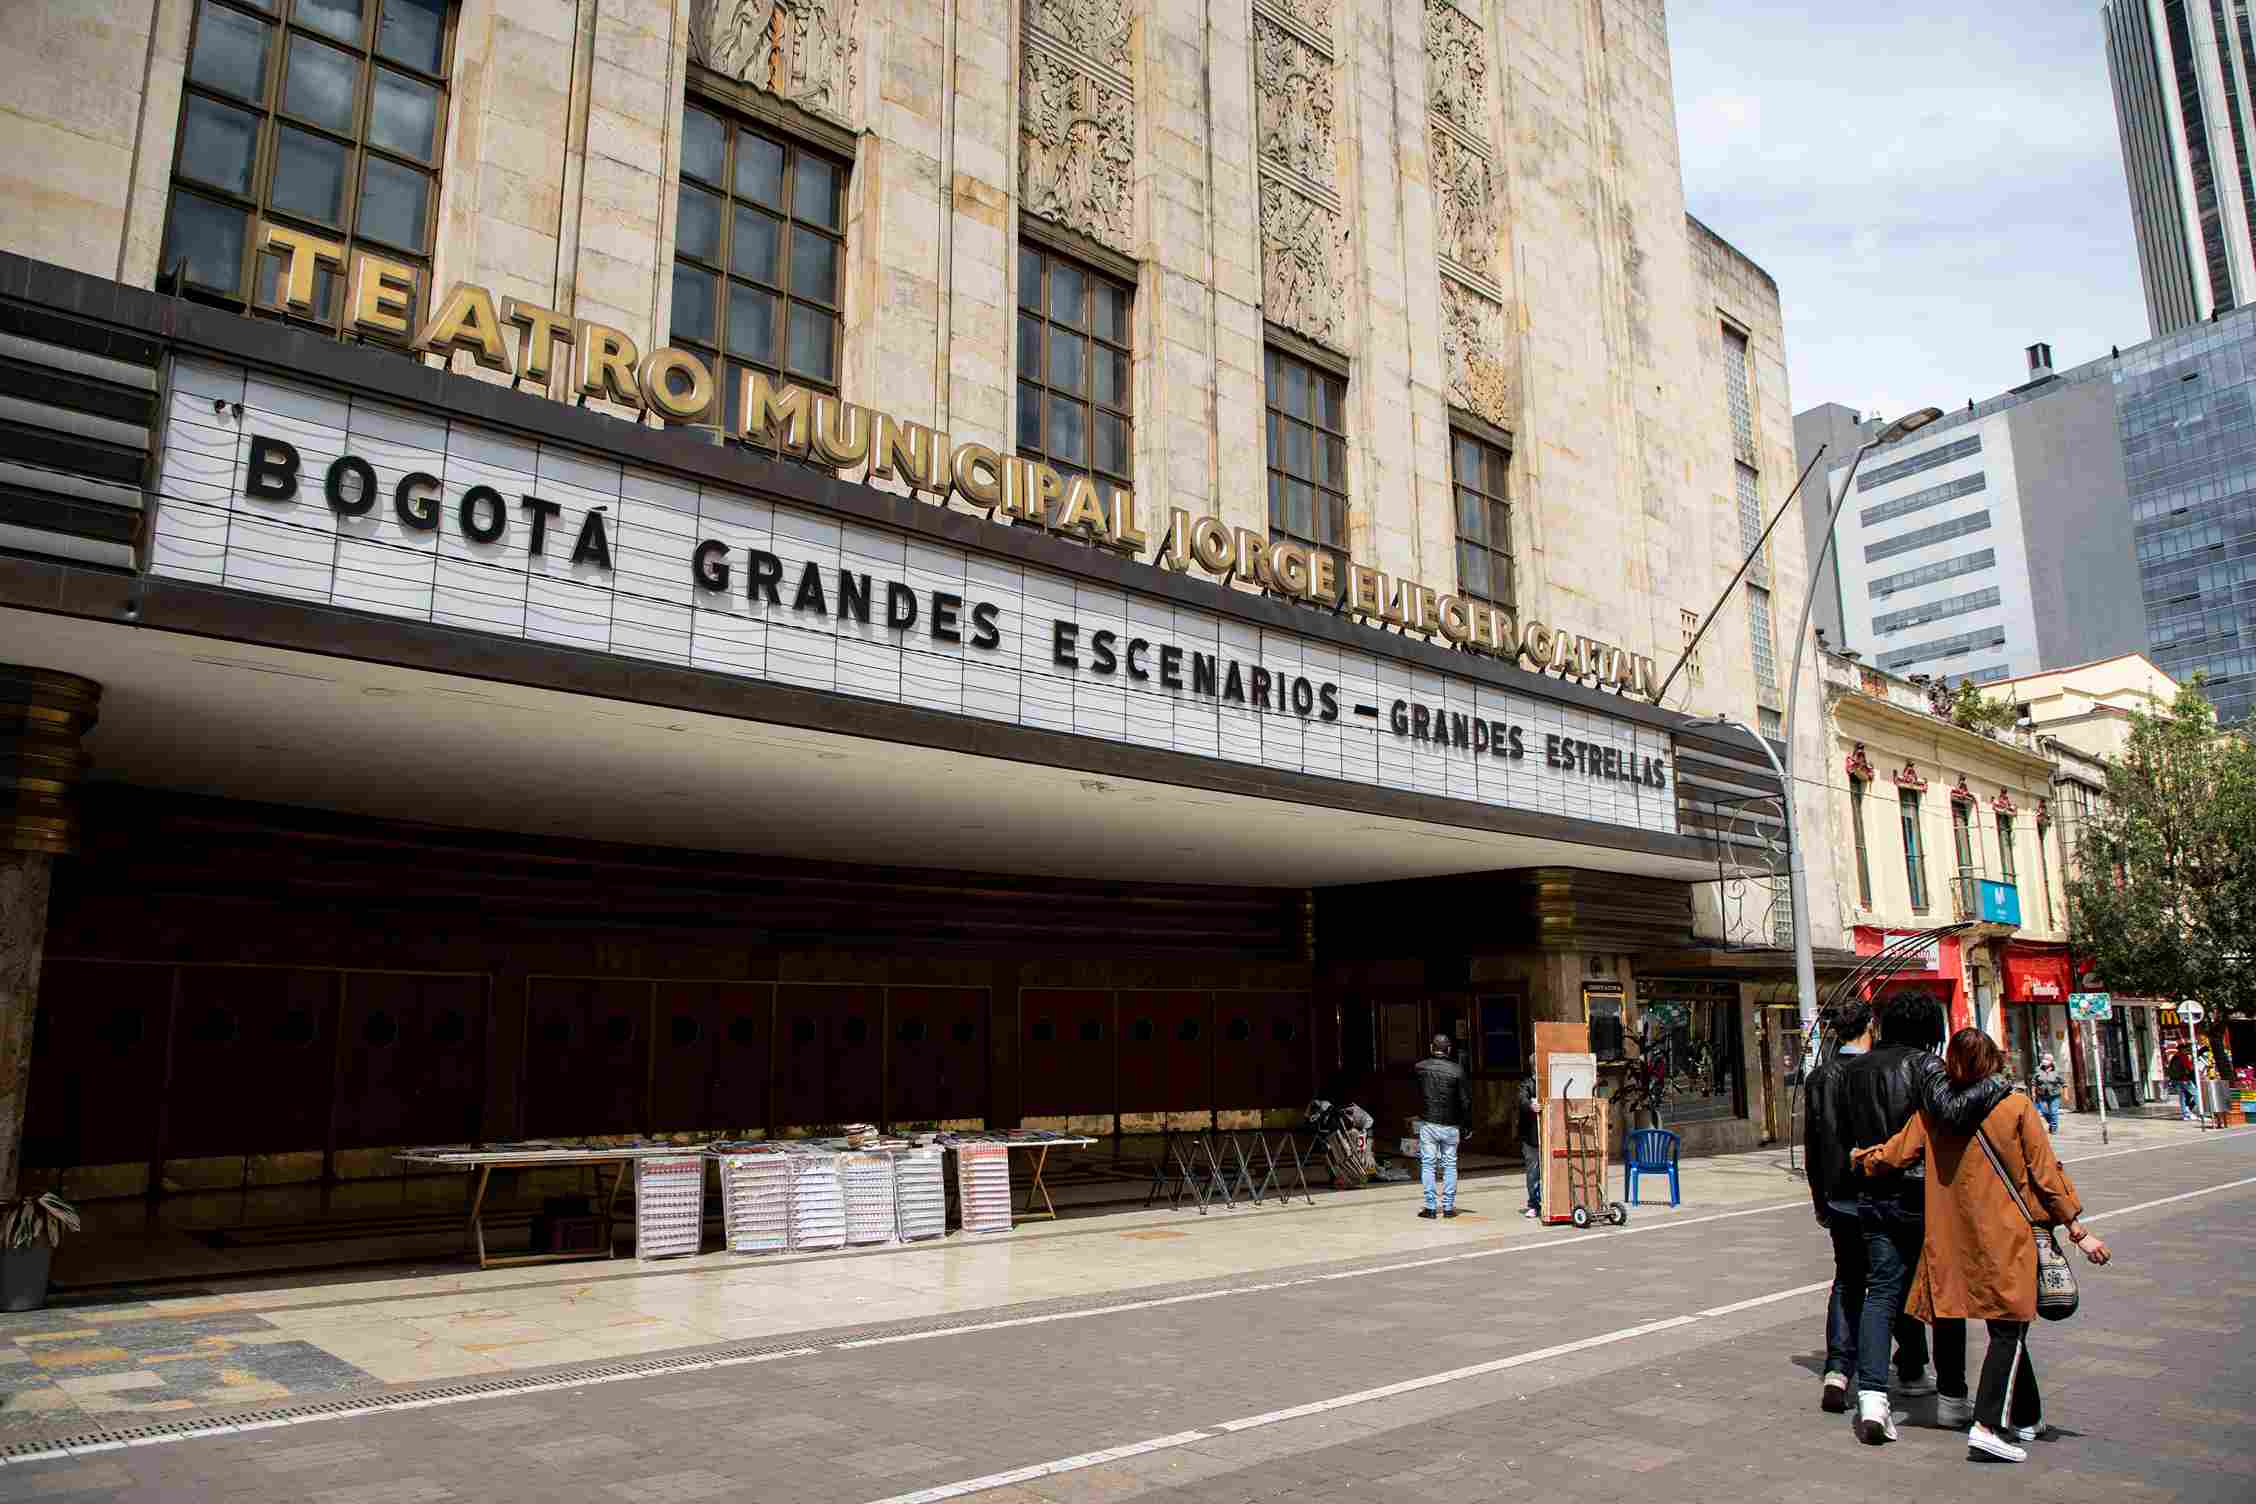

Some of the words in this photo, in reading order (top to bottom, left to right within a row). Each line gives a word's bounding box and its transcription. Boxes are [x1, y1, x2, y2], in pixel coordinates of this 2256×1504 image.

[257, 226, 714, 424] TEATRO
[739, 367, 1147, 553] MUNICIPAL
[1165, 507, 1338, 603] JORGE
[246, 433, 614, 571] BOGOTÁ
[692, 539, 1001, 650] GRANDES
[1053, 619, 1339, 721] ESCENARIOS
[1390, 699, 1525, 760] GRANDES
[1545, 733, 1667, 790] ESTRELLAS
